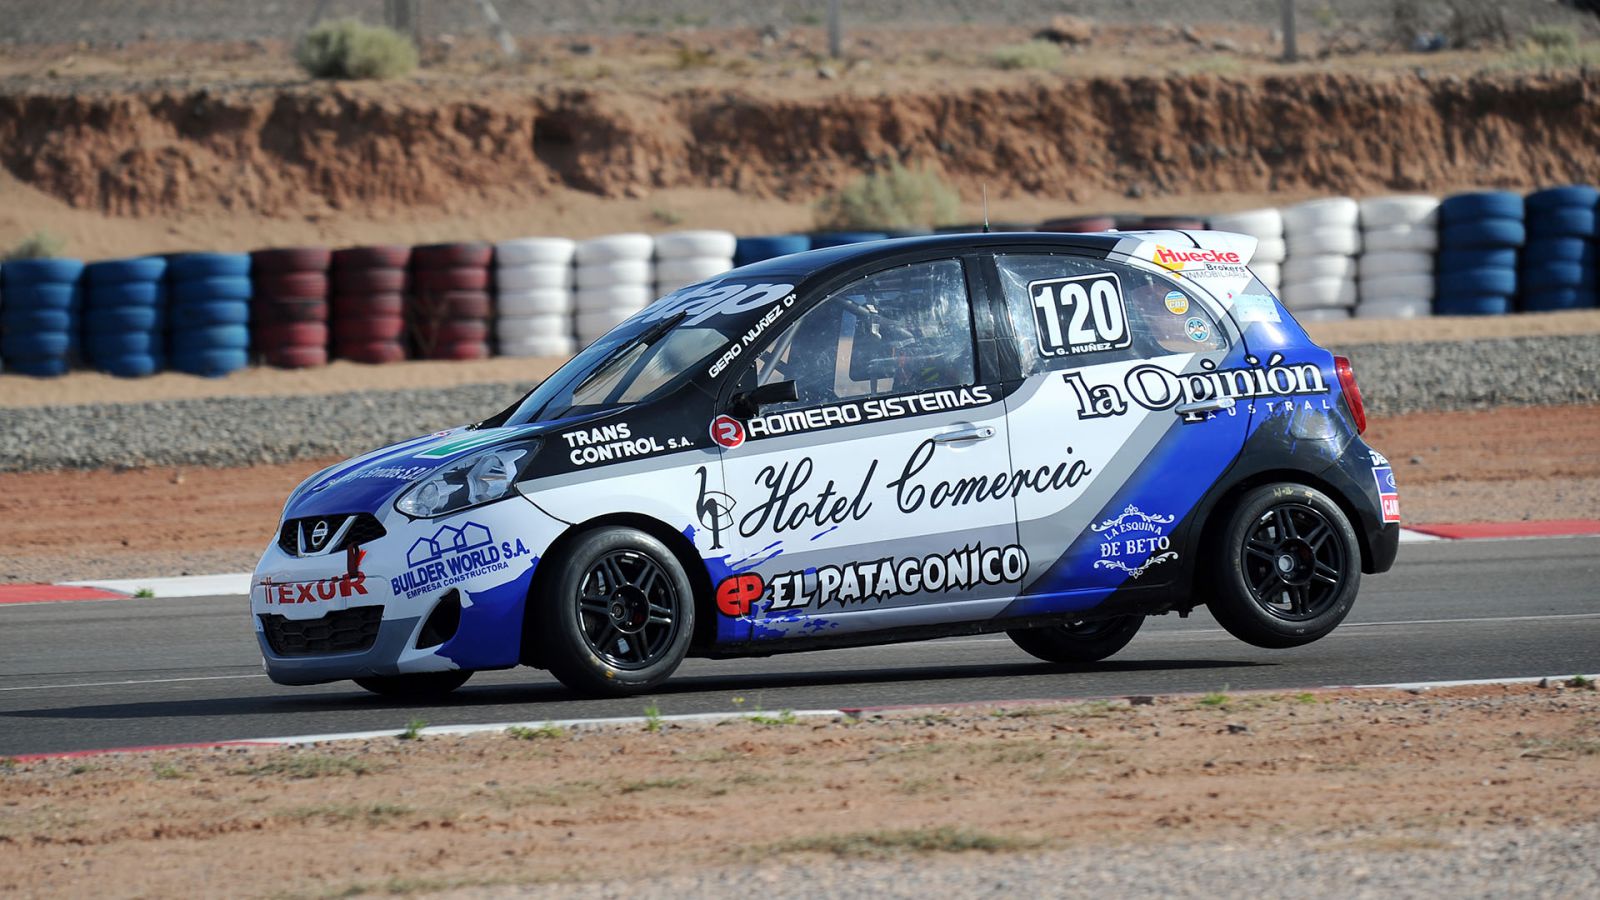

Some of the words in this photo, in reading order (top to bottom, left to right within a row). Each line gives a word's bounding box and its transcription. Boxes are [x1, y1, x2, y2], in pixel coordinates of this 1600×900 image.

[1157, 249, 1240, 263] Huecke
[1206, 263, 1245, 273] Brokers
[1034, 279, 1124, 347] 120
[708, 343, 742, 379] GERO
[742, 305, 784, 346] NUÑEZ
[1056, 347, 1070, 356] G.
[1071, 342, 1114, 353] NUÑEZ
[1064, 371, 1127, 420] la
[1125, 352, 1331, 425] Opinión
[747, 403, 862, 438] ROMERO
[863, 385, 993, 418] SISTEMAS
[1206, 400, 1331, 421] AUSTRAL
[562, 422, 632, 448] TRANS
[569, 436, 665, 466] CONTROL
[667, 436, 695, 449] S.A.
[739, 456, 879, 538] Hotel
[885, 438, 1093, 515] Comercio
[1100, 541, 1121, 558] DE
[1125, 535, 1170, 555] BETO
[1104, 528, 1120, 541] LA
[1120, 521, 1162, 536] ESQUINA
[390, 560, 449, 596] BUILDER
[446, 545, 500, 576] WORLD
[501, 537, 531, 560] S.A.
[406, 582, 443, 600] EMPRESA
[443, 561, 509, 586] CONSTRUCTORA
[768, 571, 811, 611] EL
[817, 543, 1028, 605] PATAGONICO
